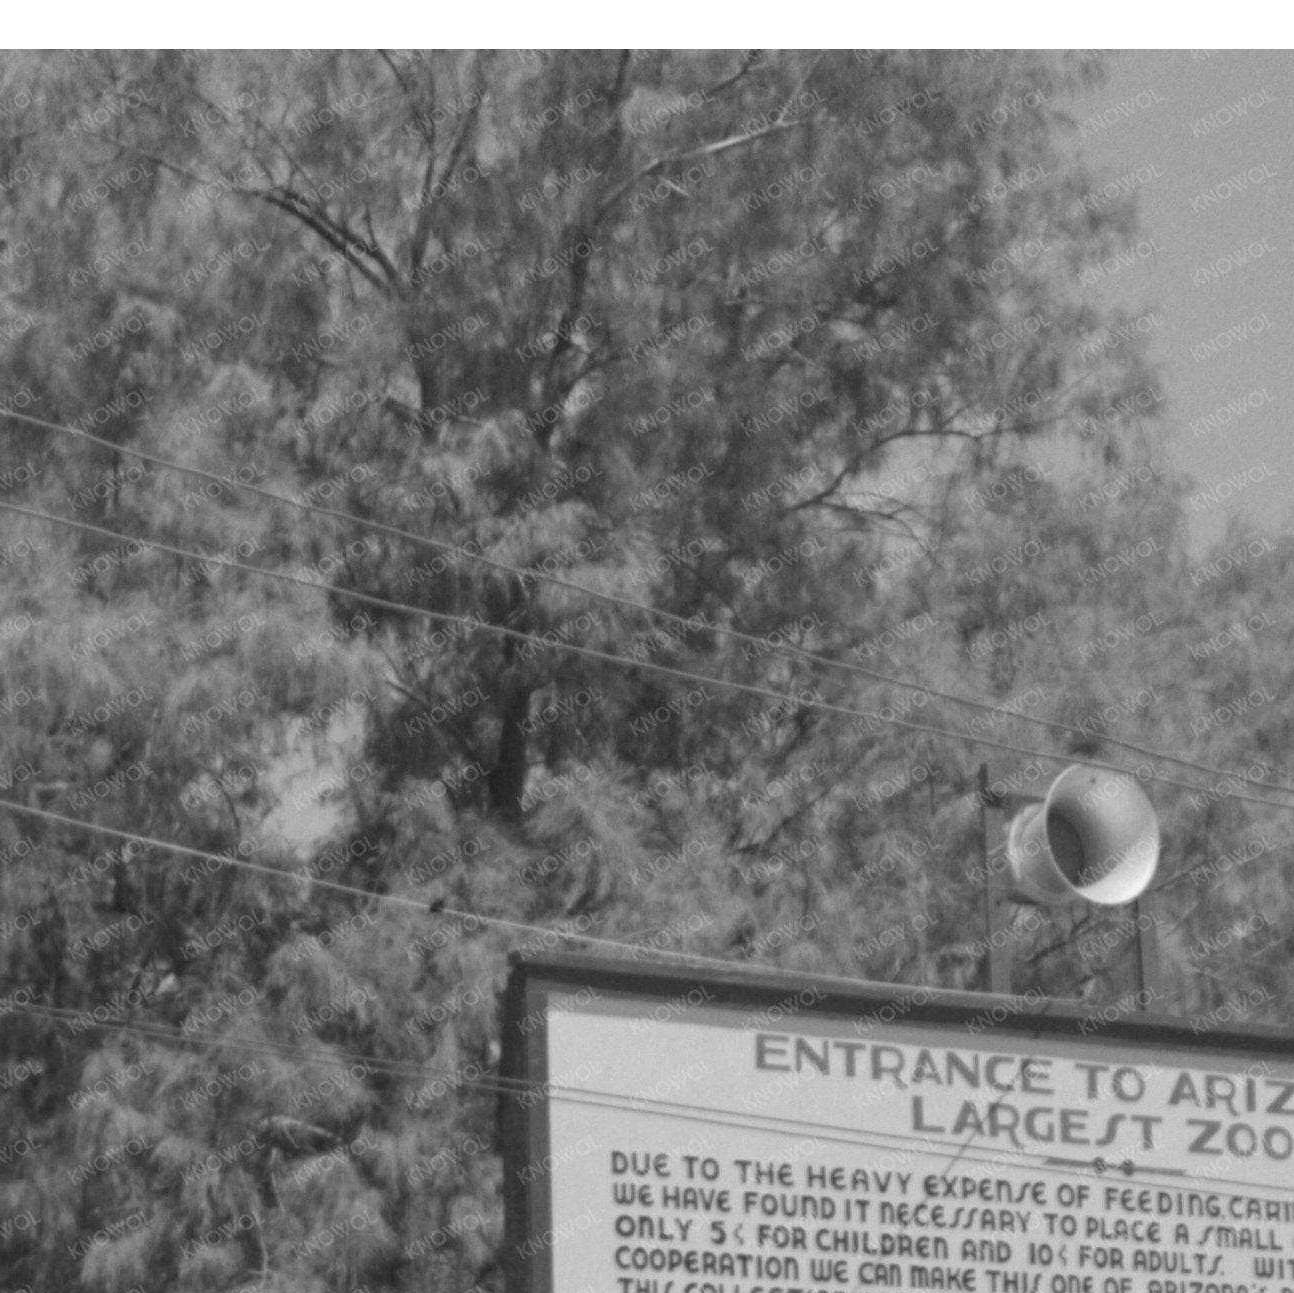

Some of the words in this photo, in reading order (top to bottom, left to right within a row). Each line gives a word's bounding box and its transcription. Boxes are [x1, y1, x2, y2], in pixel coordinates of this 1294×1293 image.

[755, 1033, 1055, 1094] ENTRANCE
[1075, 1062, 1146, 1103] TO
[909, 1096, 1163, 1152] LARGEST
[1185, 1118, 1294, 1162] ZOO
[610, 1149, 672, 1179] DUE
[681, 1154, 721, 1183] TO
[733, 1159, 795, 1189] THE
[805, 1164, 912, 1195] HEAVY
[921, 1173, 1048, 1207] EXPENSE
[1056, 1182, 1091, 1209] OF
[612, 1182, 655, 1209] WE
[661, 1185, 732, 1214] HAVE
[742, 1190, 837, 1221] FOUND
[843, 1198, 871, 1224] IT
[878, 1200, 1032, 1234] NECESSARY
[1042, 1212, 1078, 1238] TO
[1084, 1215, 1162, 1245] PLACE
[1173, 1222, 1190, 1245] A
[1196, 1225, 1284, 1253] SMALL
[613, 1213, 693, 1243] ONLY
[756, 1223, 808, 1251] FOR
[814, 1227, 949, 1260] CHILDREN
[960, 1238, 1013, 1265] AND
[1077, 1244, 1125, 1270] FOR
[614, 1244, 800, 1281] COOPERATION
[809, 1258, 850, 1285] WE
[857, 1261, 903, 1288] CAN
[909, 1264, 977, 1293] MAKE
